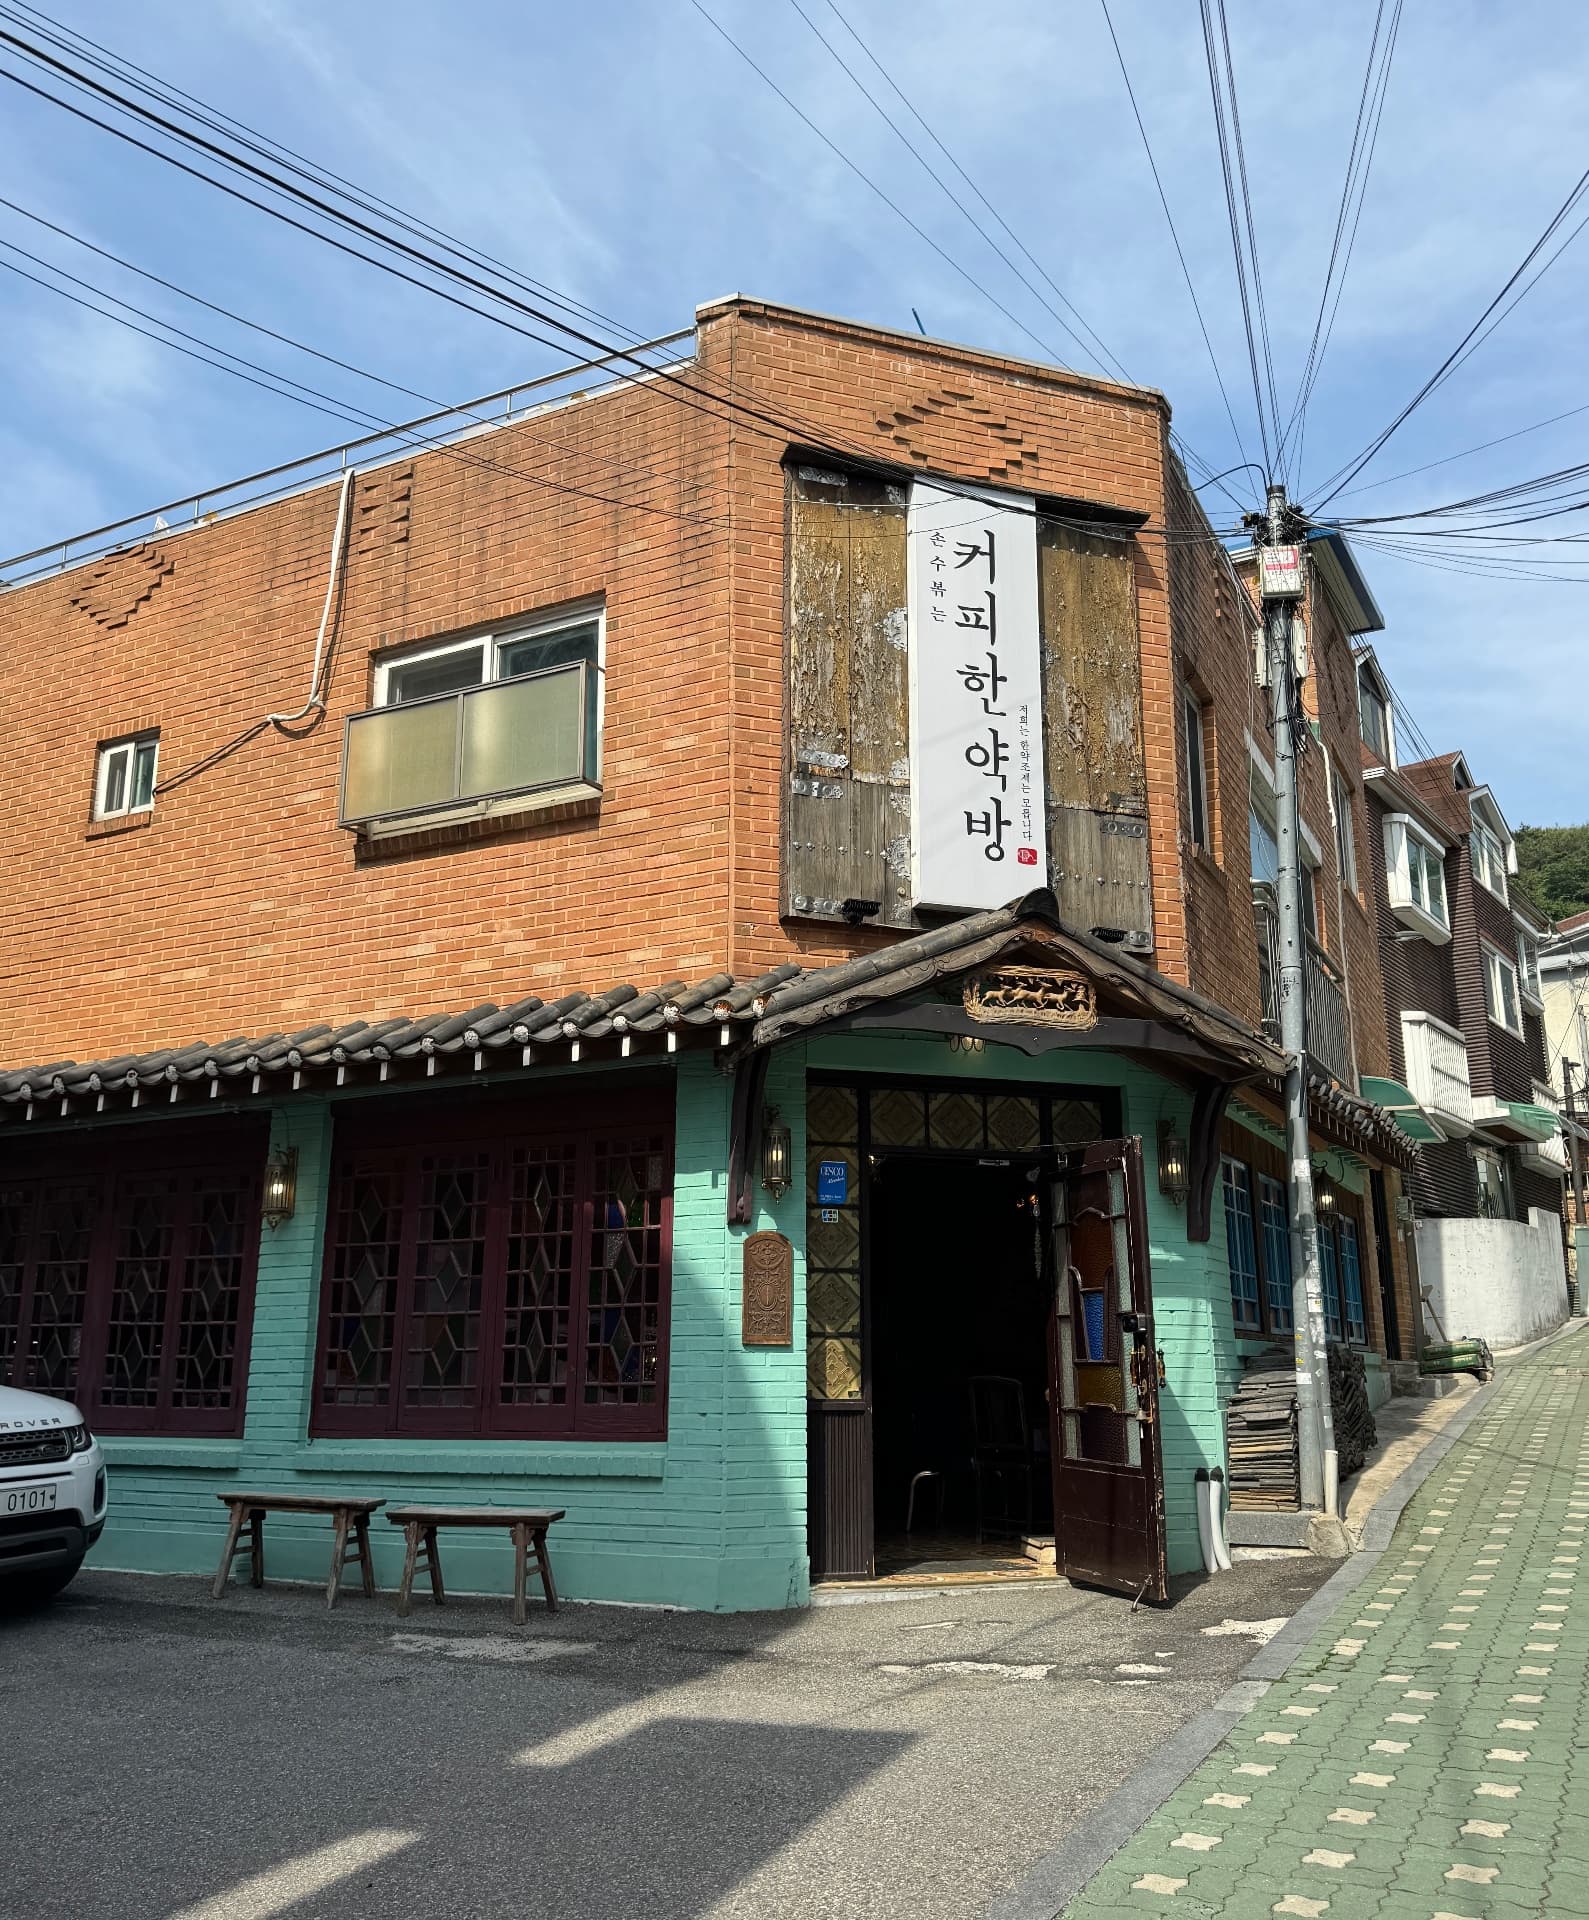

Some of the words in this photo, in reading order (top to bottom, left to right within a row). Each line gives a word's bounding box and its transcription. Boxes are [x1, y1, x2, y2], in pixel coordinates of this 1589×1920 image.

[820, 1166, 844, 1177] CESCO
[0, 1418, 61, 1430] ROVER
[8, 1490, 46, 1511] 0101
